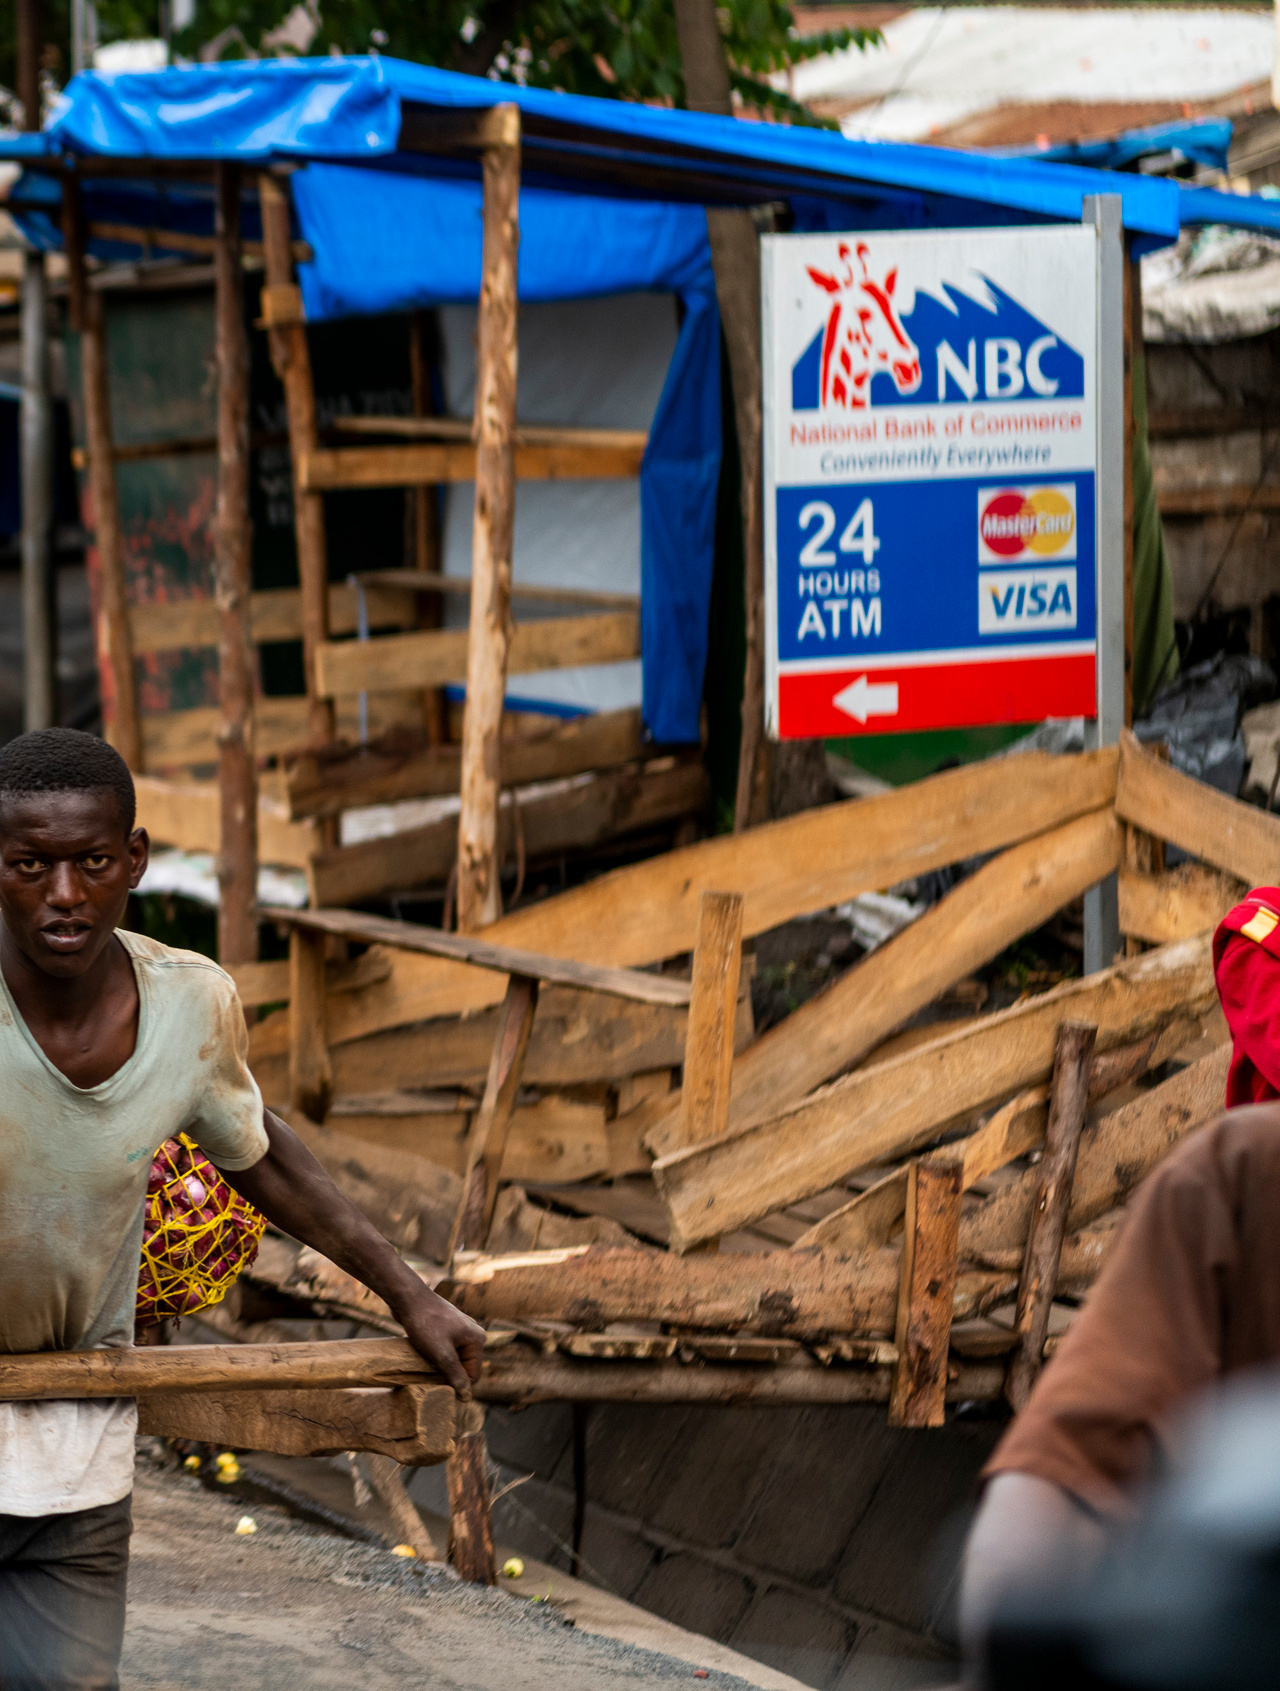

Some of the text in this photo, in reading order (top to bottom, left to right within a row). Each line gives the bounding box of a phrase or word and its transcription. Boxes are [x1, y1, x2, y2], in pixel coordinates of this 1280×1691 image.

[936, 335, 1060, 402] NBC
[790, 409, 1082, 447] National Bank of Commerce
[821, 441, 1051, 475] Conveniently Everywhere
[798, 497, 881, 568] 24
[982, 510, 1073, 539] MasterCard
[798, 568, 881, 598] HOURS
[987, 582, 1072, 618] VISA
[797, 596, 882, 642] ATM
